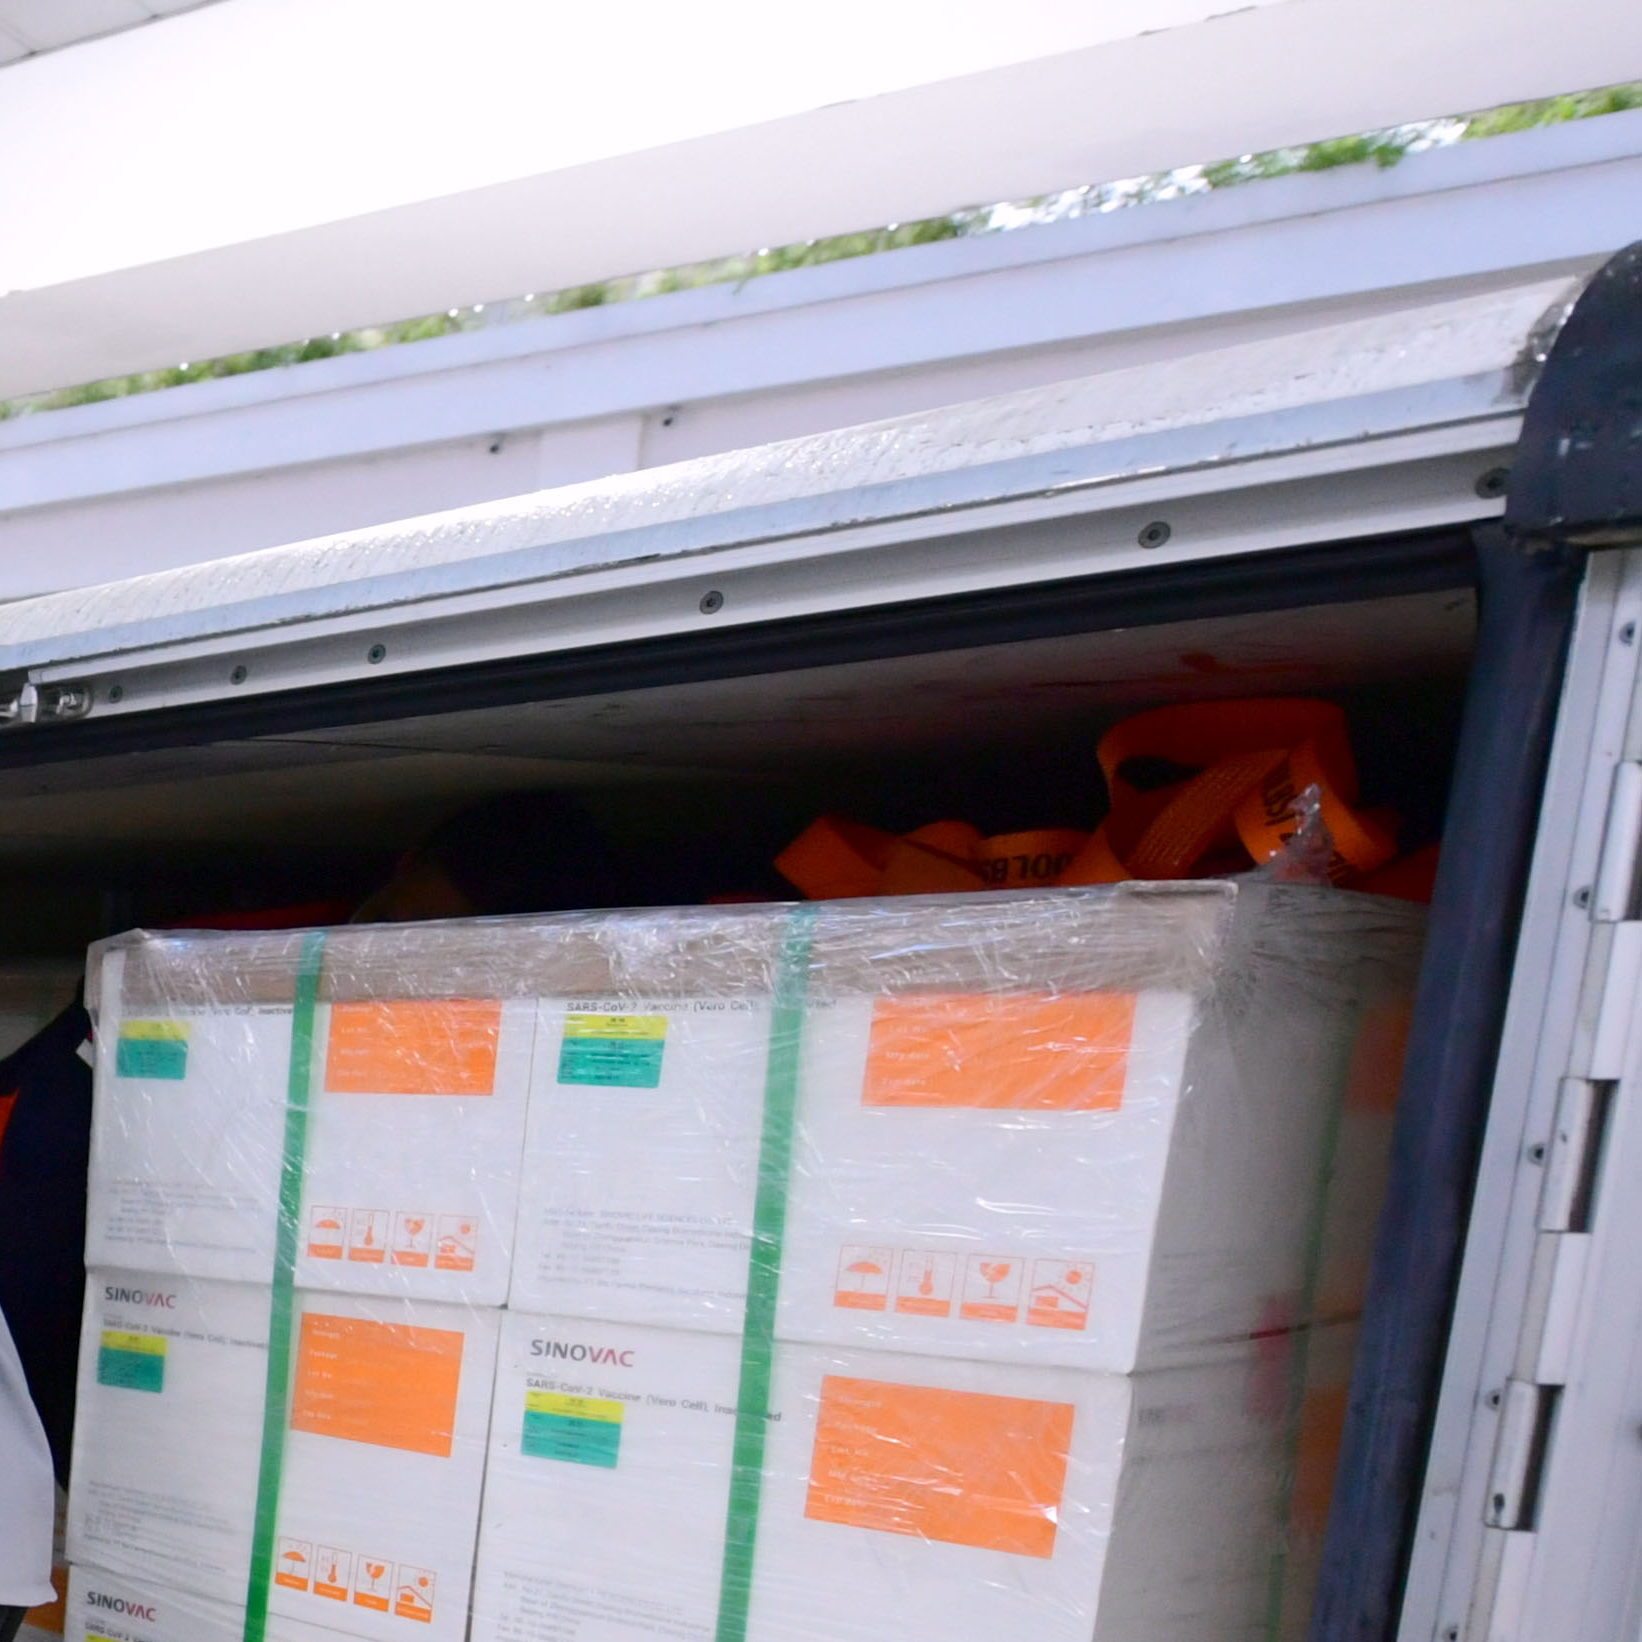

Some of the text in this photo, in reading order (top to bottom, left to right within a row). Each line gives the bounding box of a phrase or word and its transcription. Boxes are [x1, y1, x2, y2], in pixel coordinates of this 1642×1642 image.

[105, 1286, 176, 1309] SINOVAC
[530, 1338, 635, 1368] SINOVAC
[87, 1591, 157, 1622] SINOVAC
